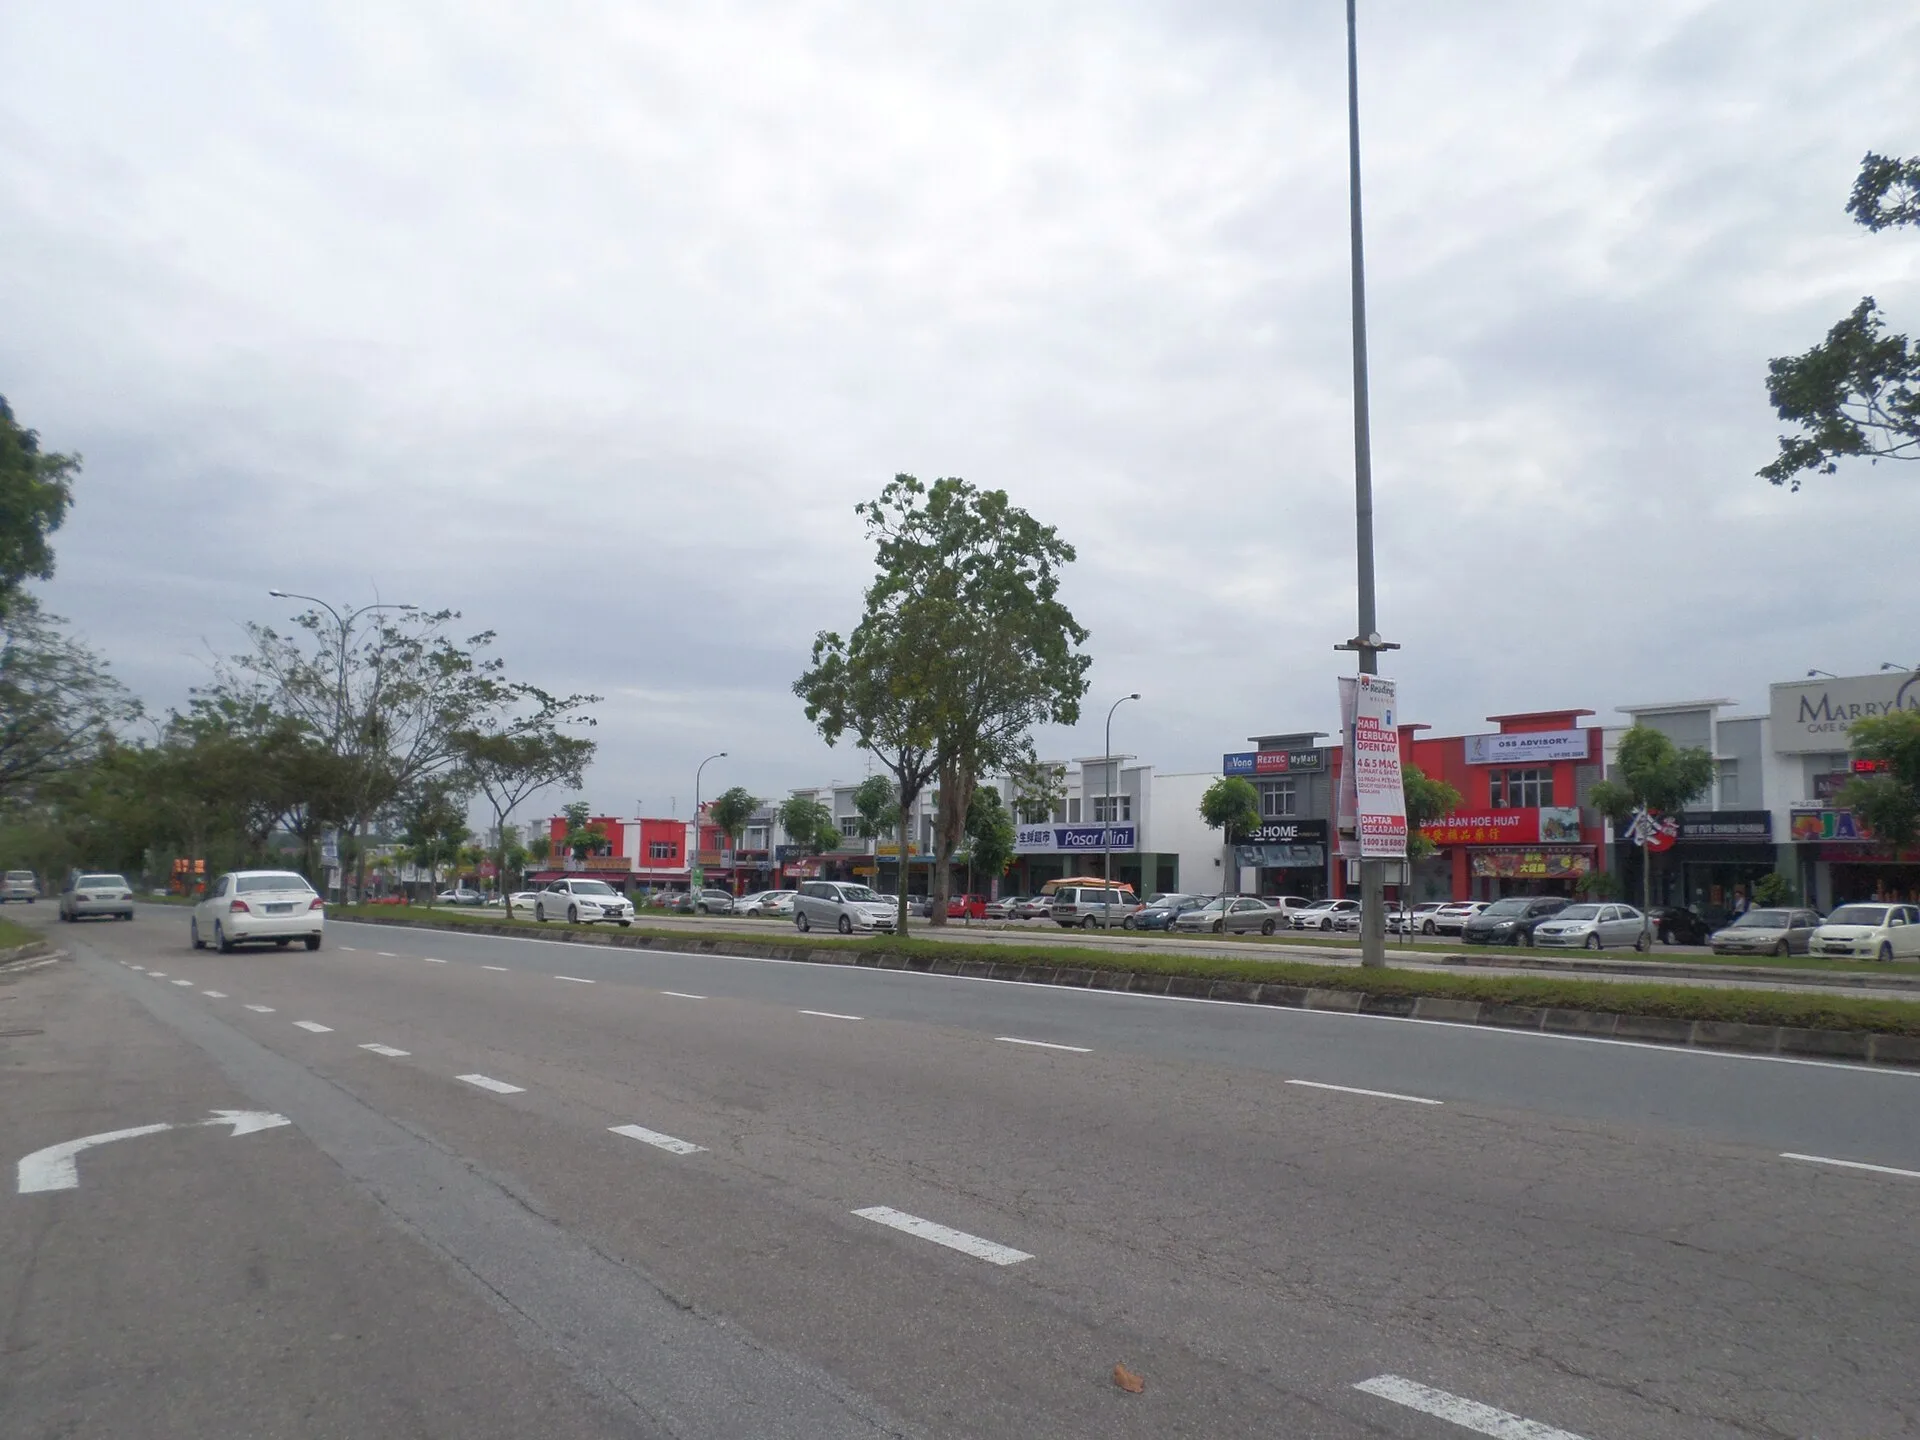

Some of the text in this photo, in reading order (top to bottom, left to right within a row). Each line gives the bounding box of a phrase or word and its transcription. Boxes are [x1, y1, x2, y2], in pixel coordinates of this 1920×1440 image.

[1370, 684, 1394, 697] Reading
[1797, 693, 1893, 722] MARRY
[1358, 719, 1377, 729] HARI
[1807, 723, 1837, 733] CAFE
[1357, 730, 1395, 742] TERBUKA
[1357, 741, 1396, 753] OPEN DAY
[1520, 738, 1568, 746] ADVISORY
[1232, 757, 1253, 767] Vono
[1357, 758, 1398, 769] 4 & 5 MAC
[1362, 816, 1392, 825] DAFTAR
[1449, 817, 1469, 827] BAN
[1470, 816, 1492, 827] HOE
[1495, 816, 1520, 826] HUAT
[1263, 825, 1298, 837] HOME
[1362, 824, 1405, 834] SEKARANG
[1064, 831, 1099, 846] Pasar
